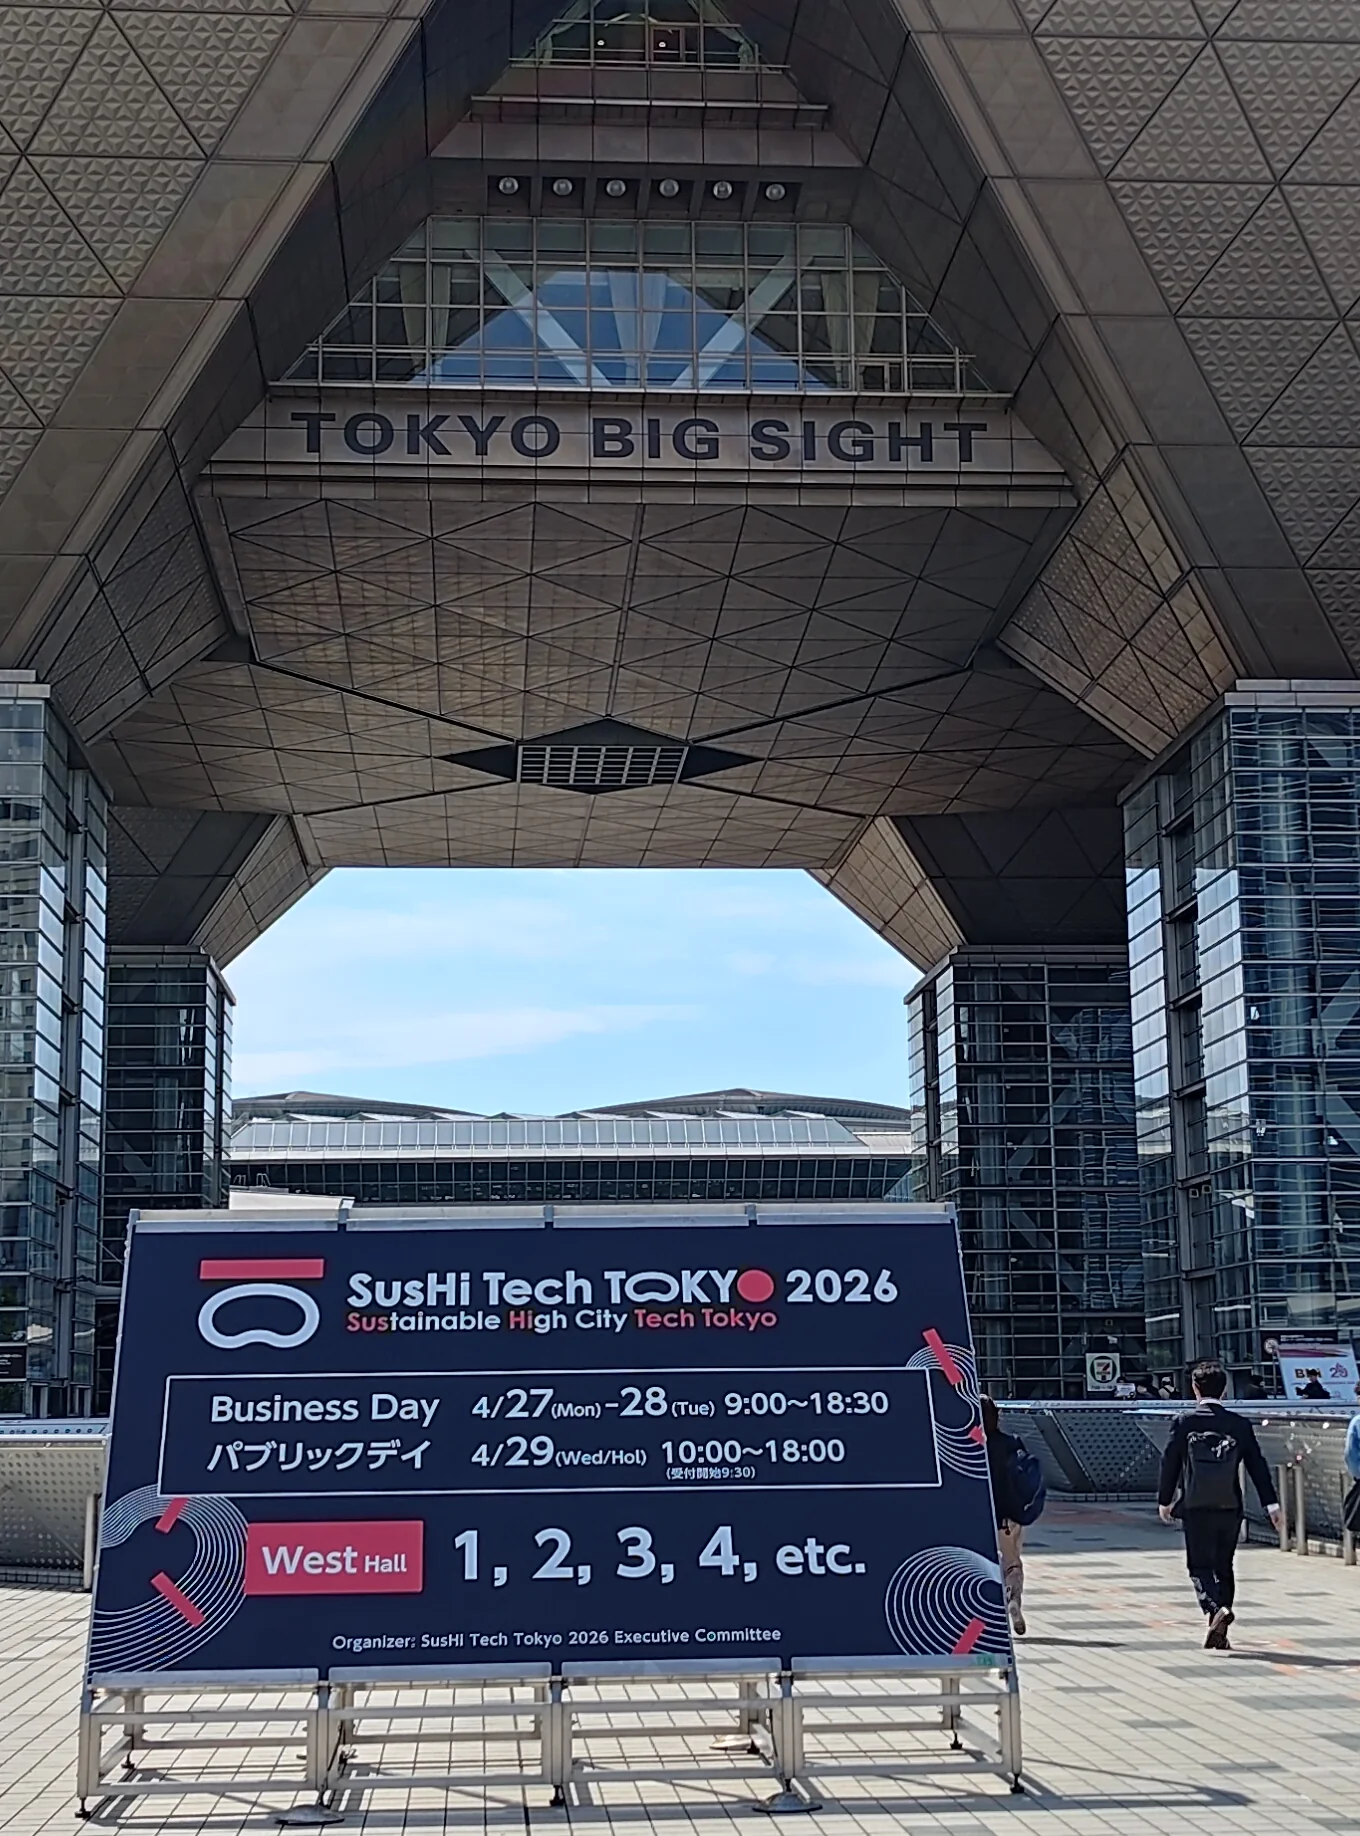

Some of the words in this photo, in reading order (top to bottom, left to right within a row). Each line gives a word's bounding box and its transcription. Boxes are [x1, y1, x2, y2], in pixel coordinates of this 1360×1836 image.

[290, 411, 561, 458] TOKYO
[592, 417, 720, 460] BIG
[750, 418, 988, 462] SIGHT
[347, 1272, 470, 1307] SusHi
[483, 1270, 592, 1305] Tech
[786, 1269, 898, 1303] 2026
[346, 1311, 501, 1332] Sustainable
[509, 1309, 567, 1334] High
[575, 1309, 628, 1333] City
[634, 1308, 695, 1328] Tech
[701, 1308, 778, 1331] Tokyo
[210, 1393, 360, 1423] Business
[371, 1393, 441, 1427] Day
[206, 1440, 431, 1472] パブリックデイ
[261, 1545, 358, 1575] West
[364, 1553, 408, 1573] Hall
[454, 1529, 508, 1587] 1,
[531, 1527, 592, 1586] 2,
[616, 1526, 675, 1584] 3,
[698, 1525, 758, 1582] 4,
[775, 1537, 866, 1575] etc.
[332, 1634, 416, 1652] Organizer:
[420, 1633, 464, 1648] SusHi
[469, 1632, 508, 1647] Tech
[513, 1631, 563, 1649] Tokyo
[568, 1630, 609, 1645] 2026
[614, 1628, 690, 1644] Executive
[694, 1627, 782, 1643] Committee
